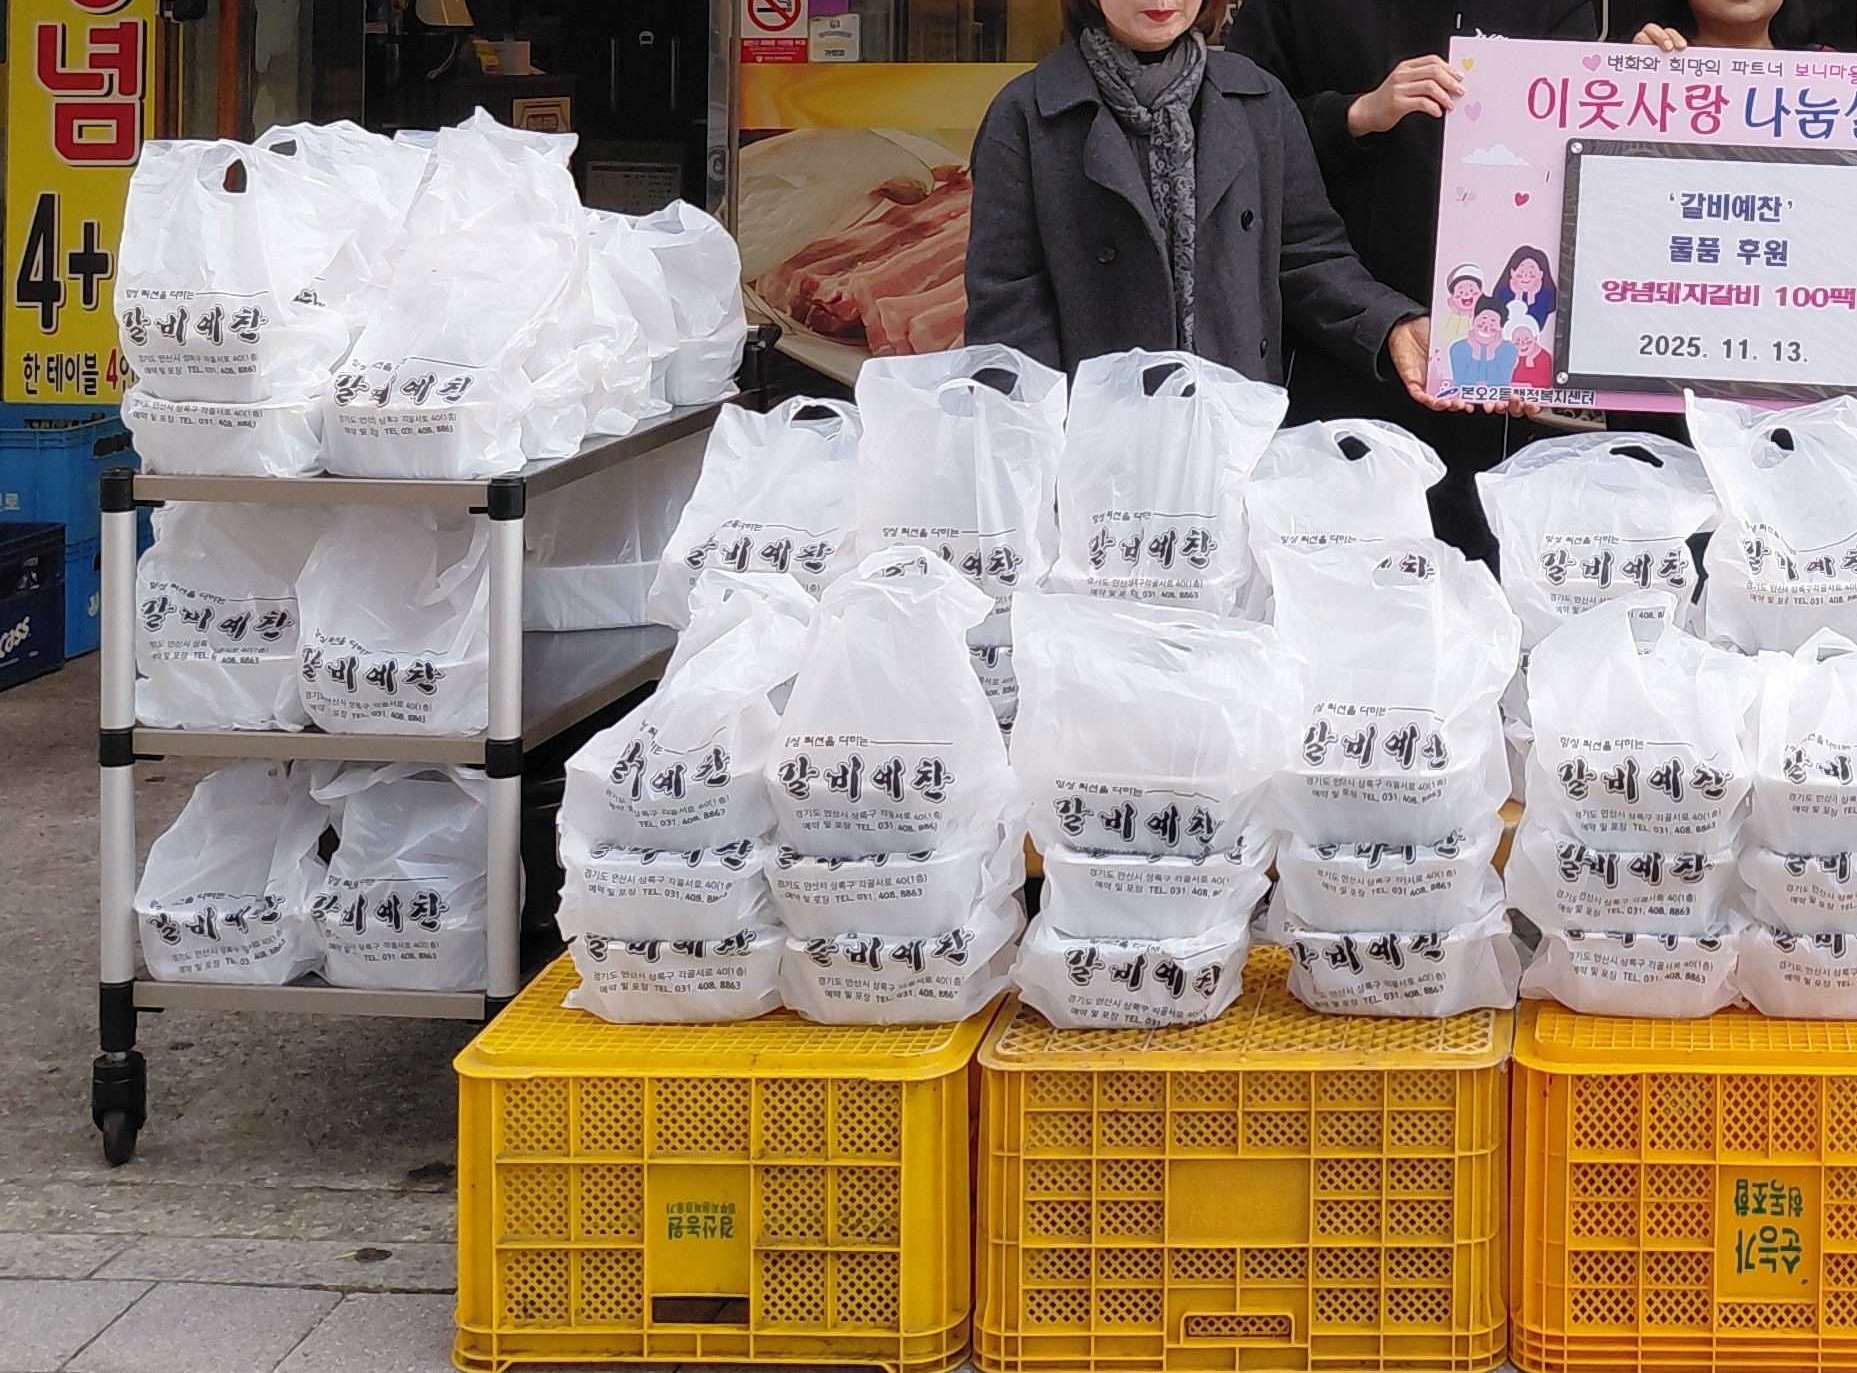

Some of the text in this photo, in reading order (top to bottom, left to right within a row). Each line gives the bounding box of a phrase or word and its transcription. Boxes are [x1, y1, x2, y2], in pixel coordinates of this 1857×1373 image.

[1607, 54, 1661, 72] 변화와
[1669, 57, 1720, 77] 희망의
[1731, 59, 1784, 78] 파트너
[1526, 76, 1730, 133] 이웃사랑
[1668, 236, 1789, 268] 물품 후원
[1601, 280, 1857, 311] 양념돼지갈비 100팩
[122, 303, 269, 347] 갈비예찬
[1638, 335, 1809, 364] 2025. 11. 13.
[23, 352, 41, 397] 한
[47, 351, 99, 397] 테이블
[778, 753, 956, 804] 갈비예찬
[1557, 755, 1734, 804] 갈비예찬
[1053, 795, 1226, 848] 갈비예찬
[668, 1215, 734, 1240] 경산농원
[1735, 1226, 1802, 1275] 순농가
